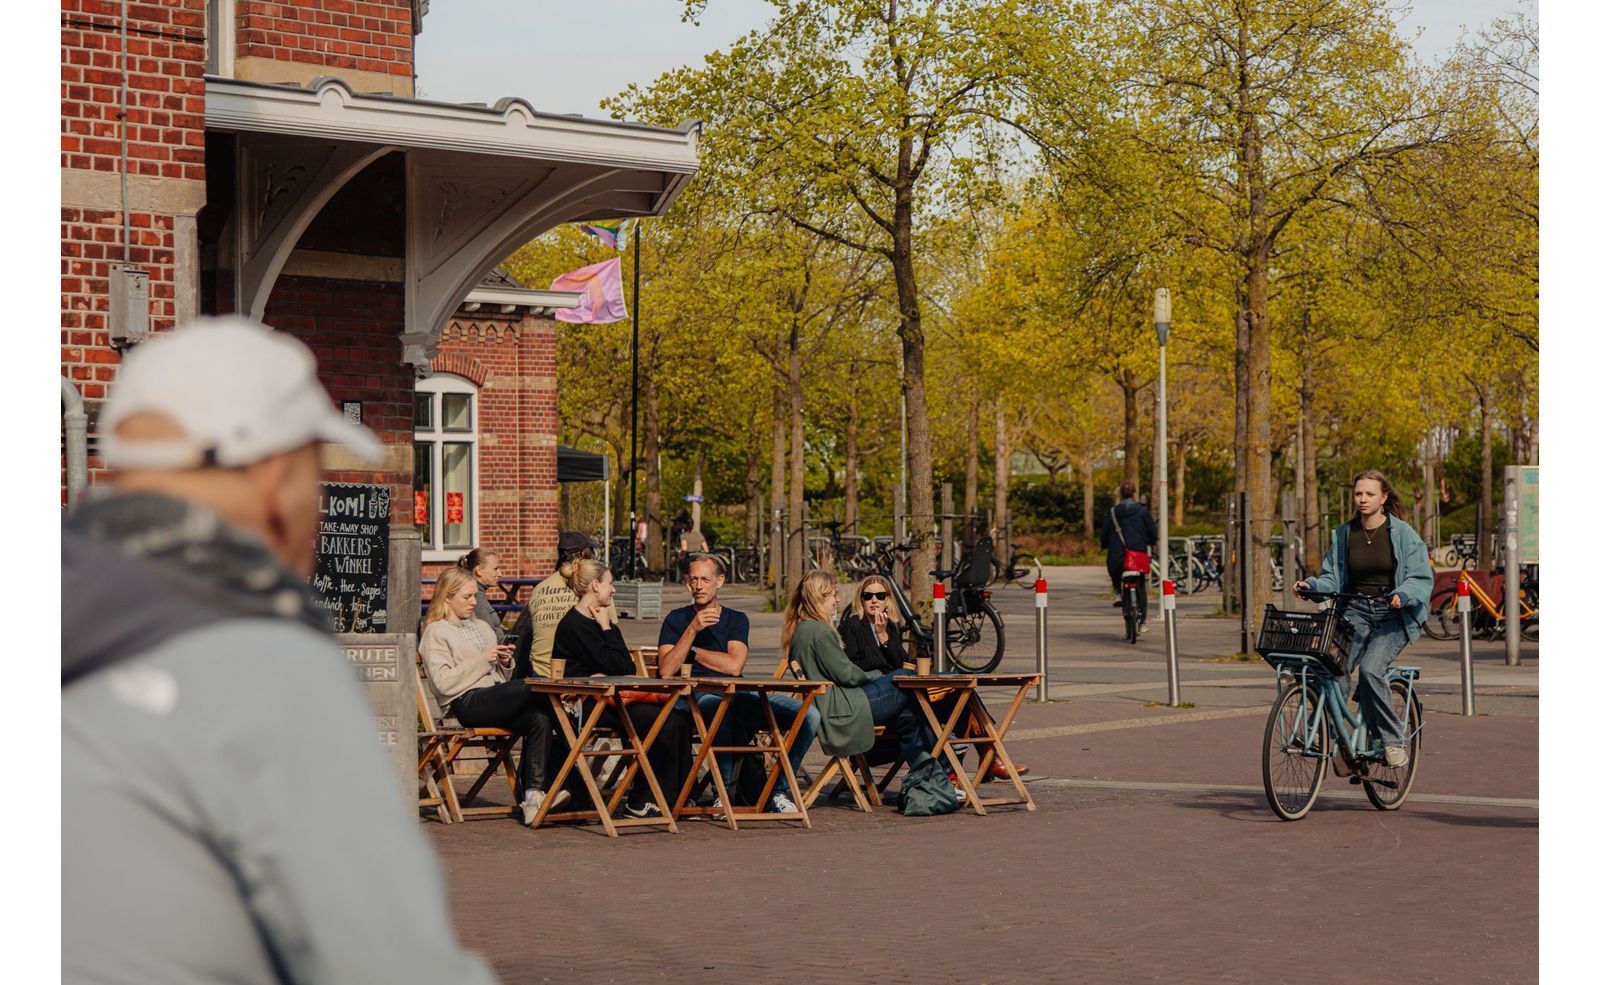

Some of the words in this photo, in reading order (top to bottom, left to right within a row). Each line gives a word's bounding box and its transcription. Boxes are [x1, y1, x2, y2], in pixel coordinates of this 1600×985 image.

[319, 494, 365, 518] LKOM!
[320, 521, 360, 533] TAKE-AWAY
[361, 524, 379, 535] SHOP
